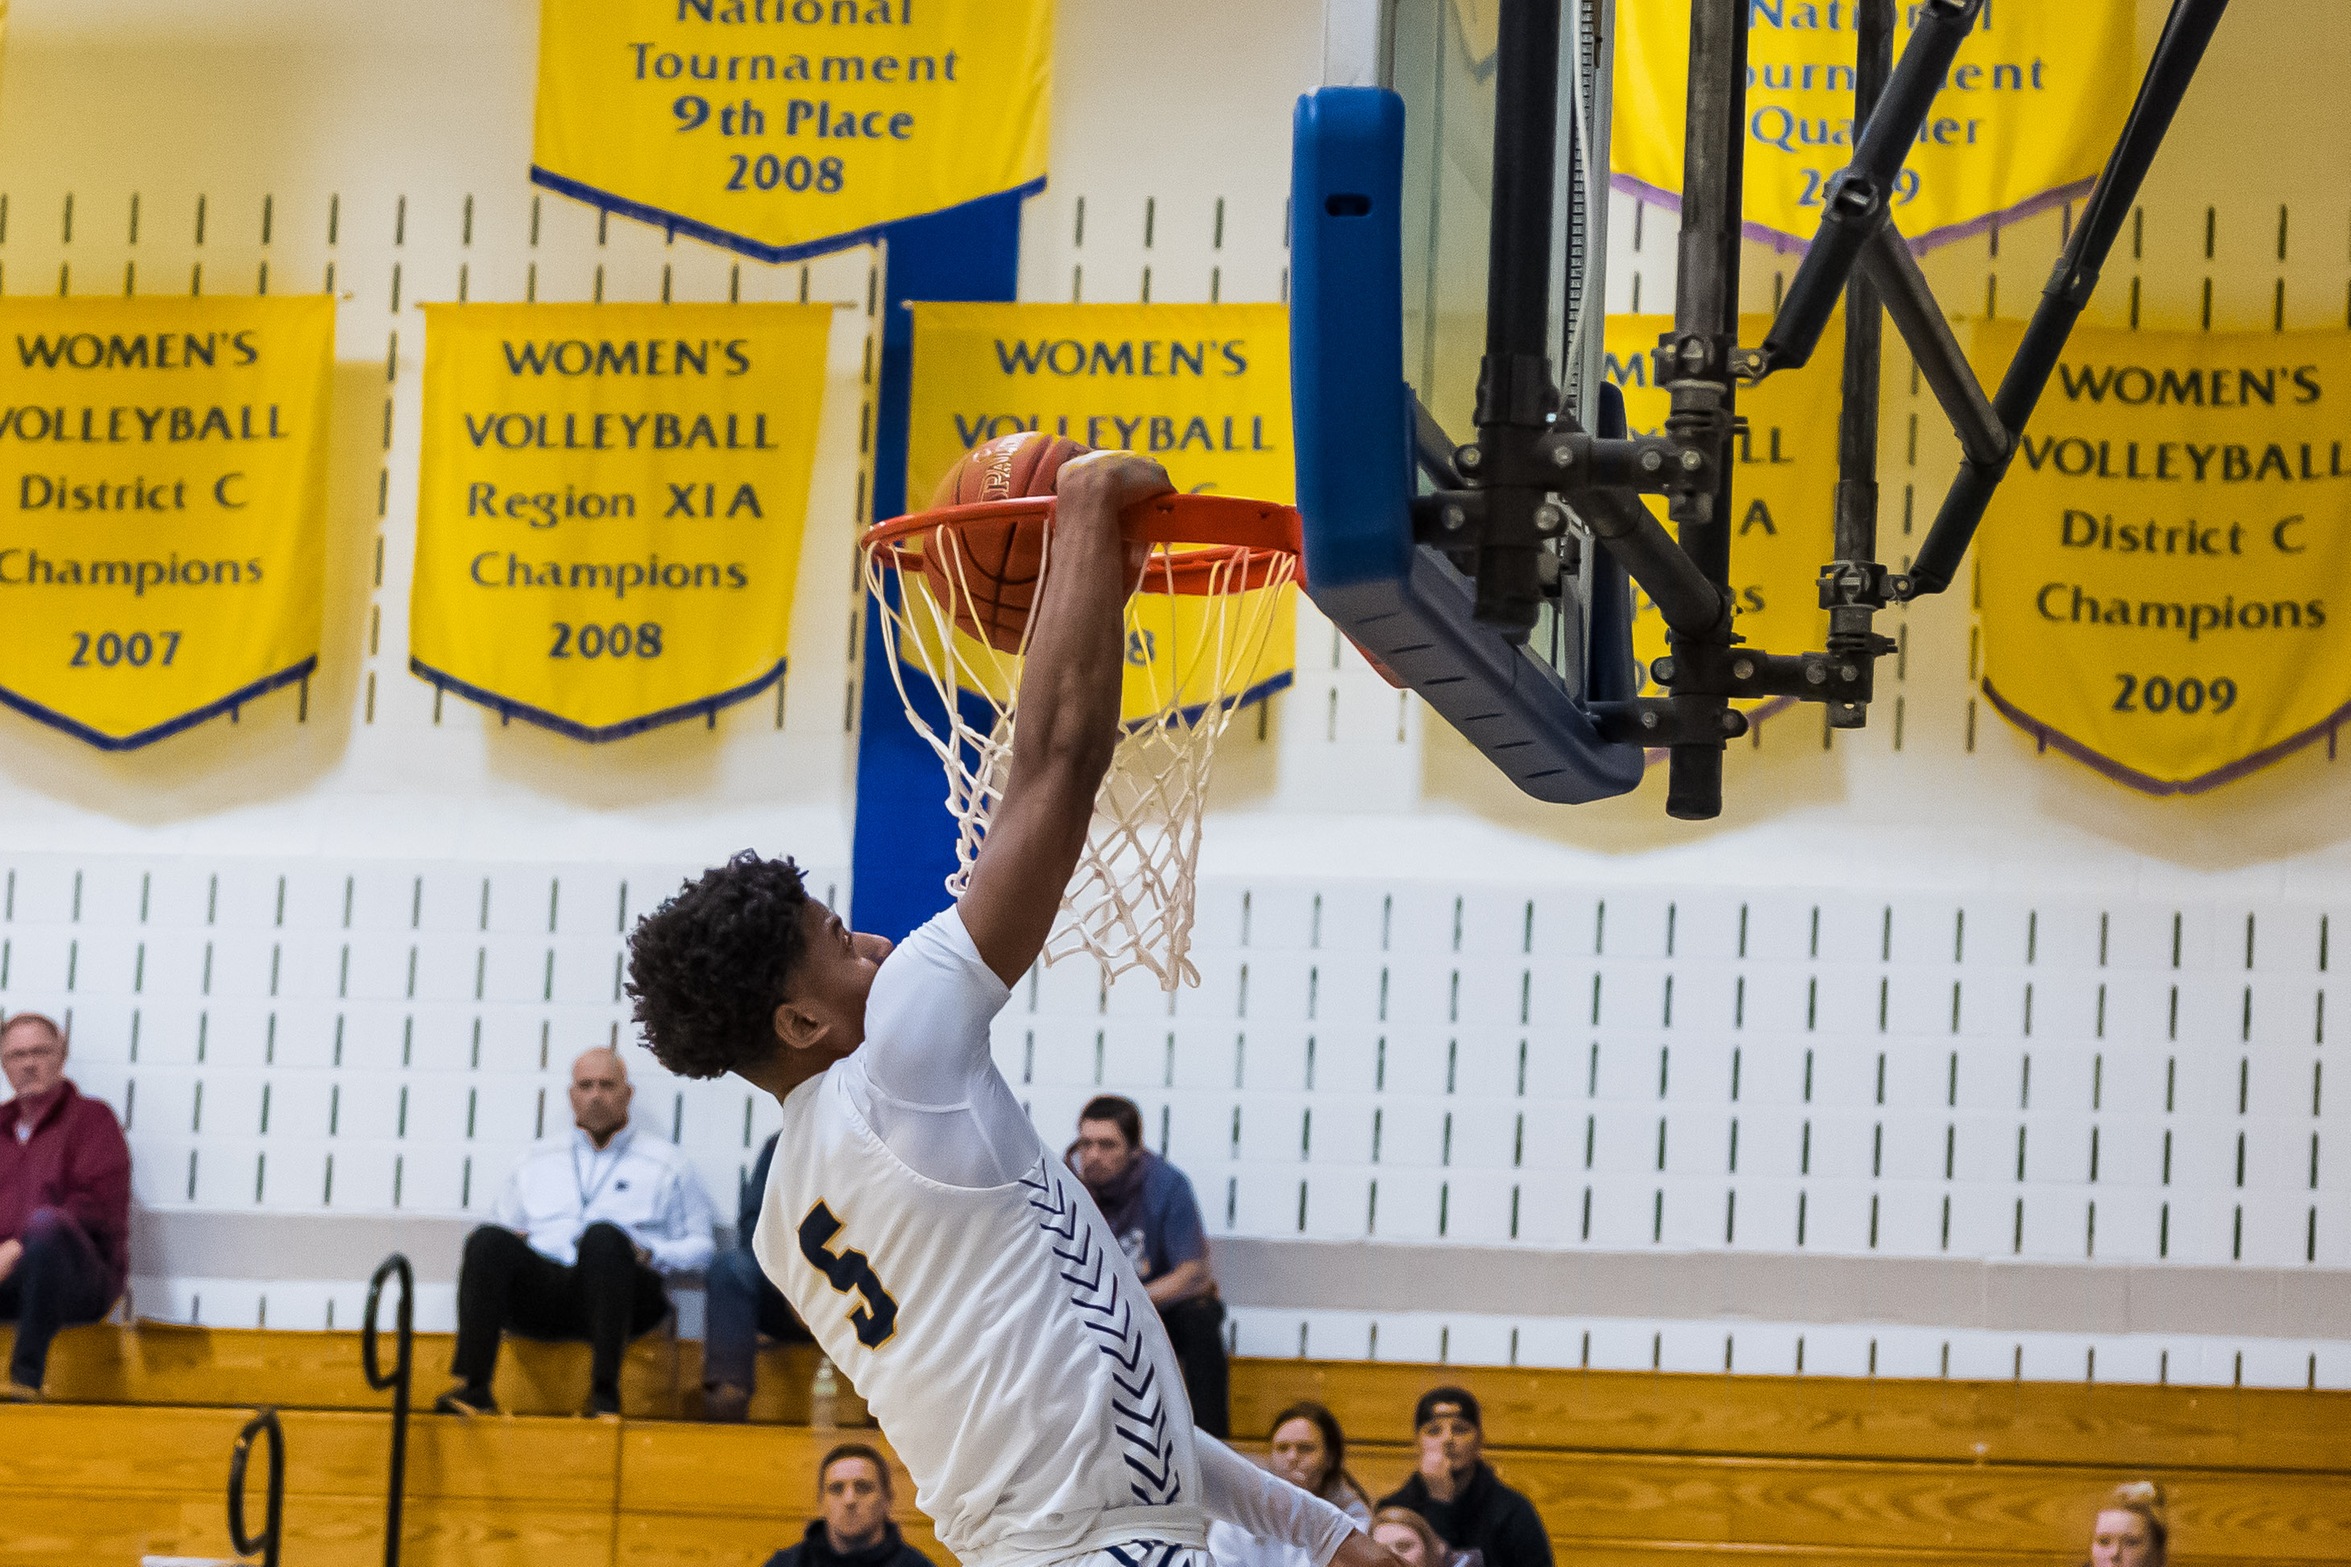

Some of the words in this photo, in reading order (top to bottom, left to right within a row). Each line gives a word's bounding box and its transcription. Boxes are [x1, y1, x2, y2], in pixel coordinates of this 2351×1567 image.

[677, 0, 913, 25] National
[1748, 0, 1991, 31] Natl
[628, 42, 961, 83] Tournament
[1747, 58, 2046, 91] urnent
[671, 95, 766, 137] 9th
[785, 98, 915, 141] Place
[724, 153, 846, 194] 2008
[1797, 168, 1921, 207] 29
[16, 331, 260, 369] WOMEN'S
[501, 339, 752, 377] WOMEN'S
[995, 338, 1250, 378] WOMEN'S
[2058, 362, 2323, 407] WOMEN'S
[463, 412, 779, 451] VOLLEYBALL
[2020, 434, 2351, 482] VOLLEYBALL
[19, 474, 186, 511] District
[213, 472, 250, 509] C
[467, 482, 637, 529] Region
[2061, 509, 2245, 556] District
[2273, 515, 2306, 555] C
[0, 548, 263, 597] Champions
[470, 551, 750, 600] Champions
[2035, 582, 2328, 643] Champions
[68, 631, 183, 669] 2007
[548, 622, 664, 660] 2008
[2110, 673, 2239, 715] 2009
[798, 1197, 899, 1351] 5
